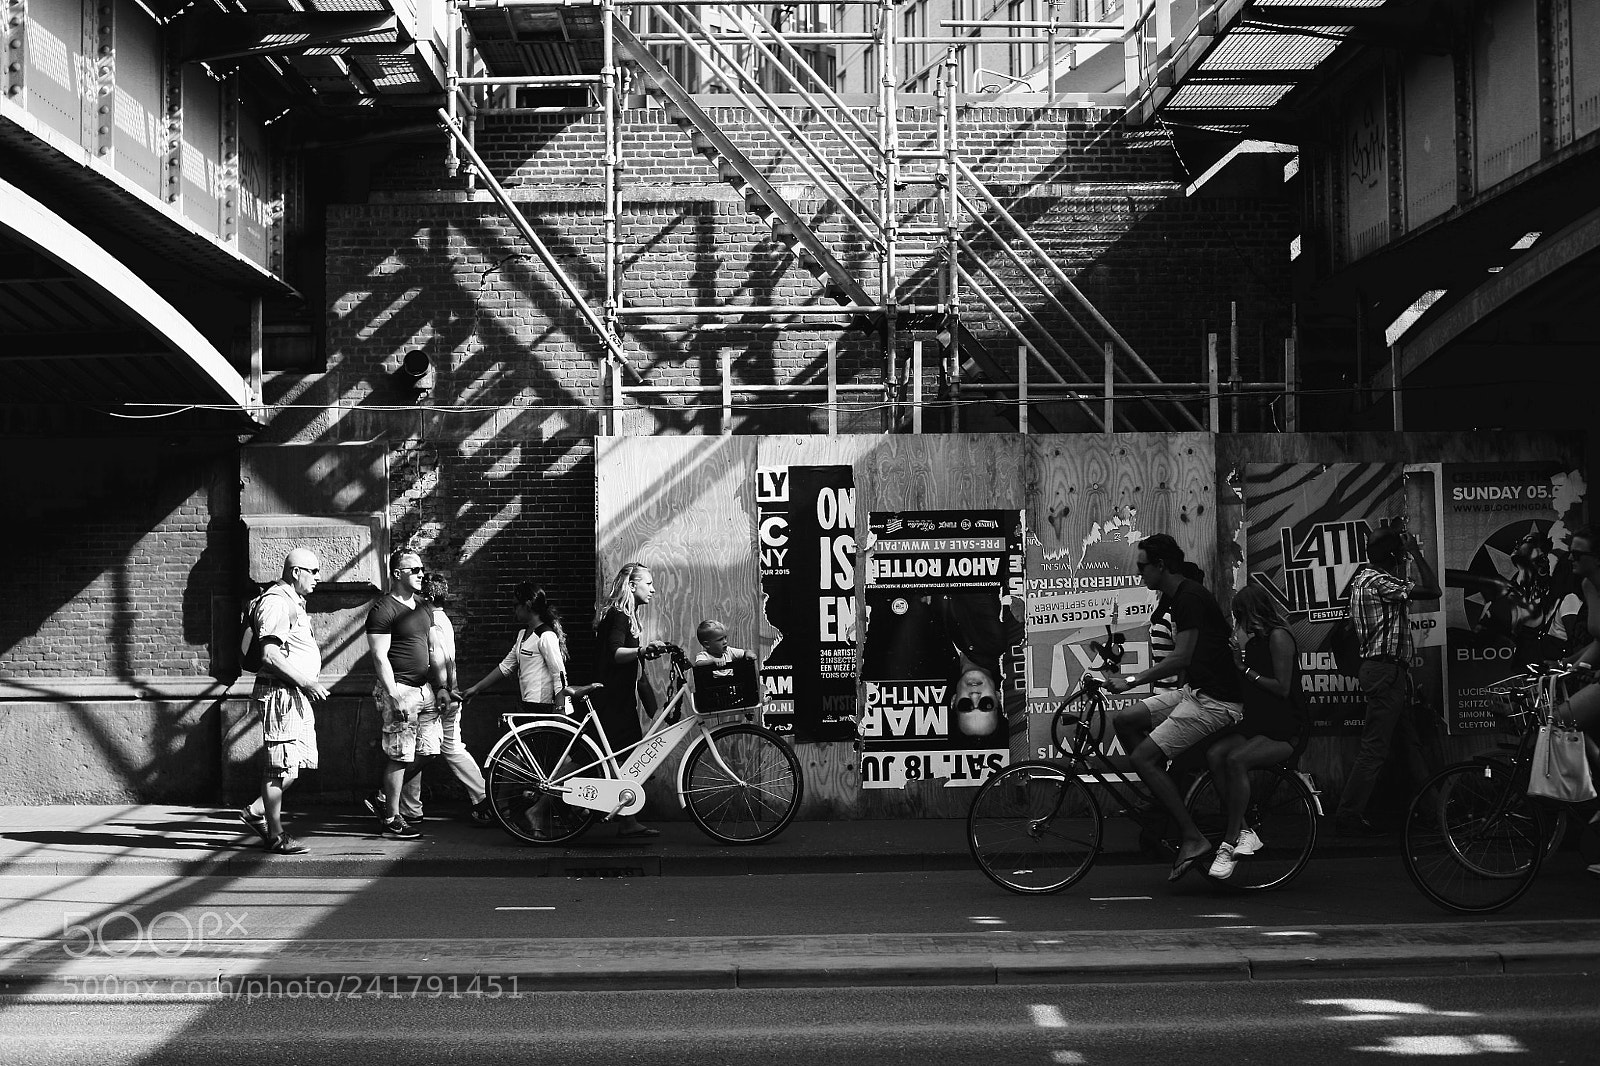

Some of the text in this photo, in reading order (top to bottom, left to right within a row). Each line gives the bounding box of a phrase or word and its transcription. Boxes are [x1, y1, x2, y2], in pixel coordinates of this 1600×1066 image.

[1452, 486, 1522, 501] SUNDAY
[934, 541, 946, 550] AT
[950, 540, 1000, 549] PRE-SALE
[820, 534, 856, 590] IS
[946, 557, 1001, 577] AHOY
[774, 568, 790, 576] 2015
[1034, 600, 1085, 613] SEPTEMBER
[1088, 599, 1098, 607] 19
[1061, 609, 1106, 623] SUCCES
[820, 649, 832, 657] 346
[1457, 647, 1517, 661] BLOO
[820, 664, 832, 672] EEN
[1305, 695, 1369, 704] ATINVILL
[1458, 711, 1485, 719] SIMON
[904, 755, 934, 780] 18
